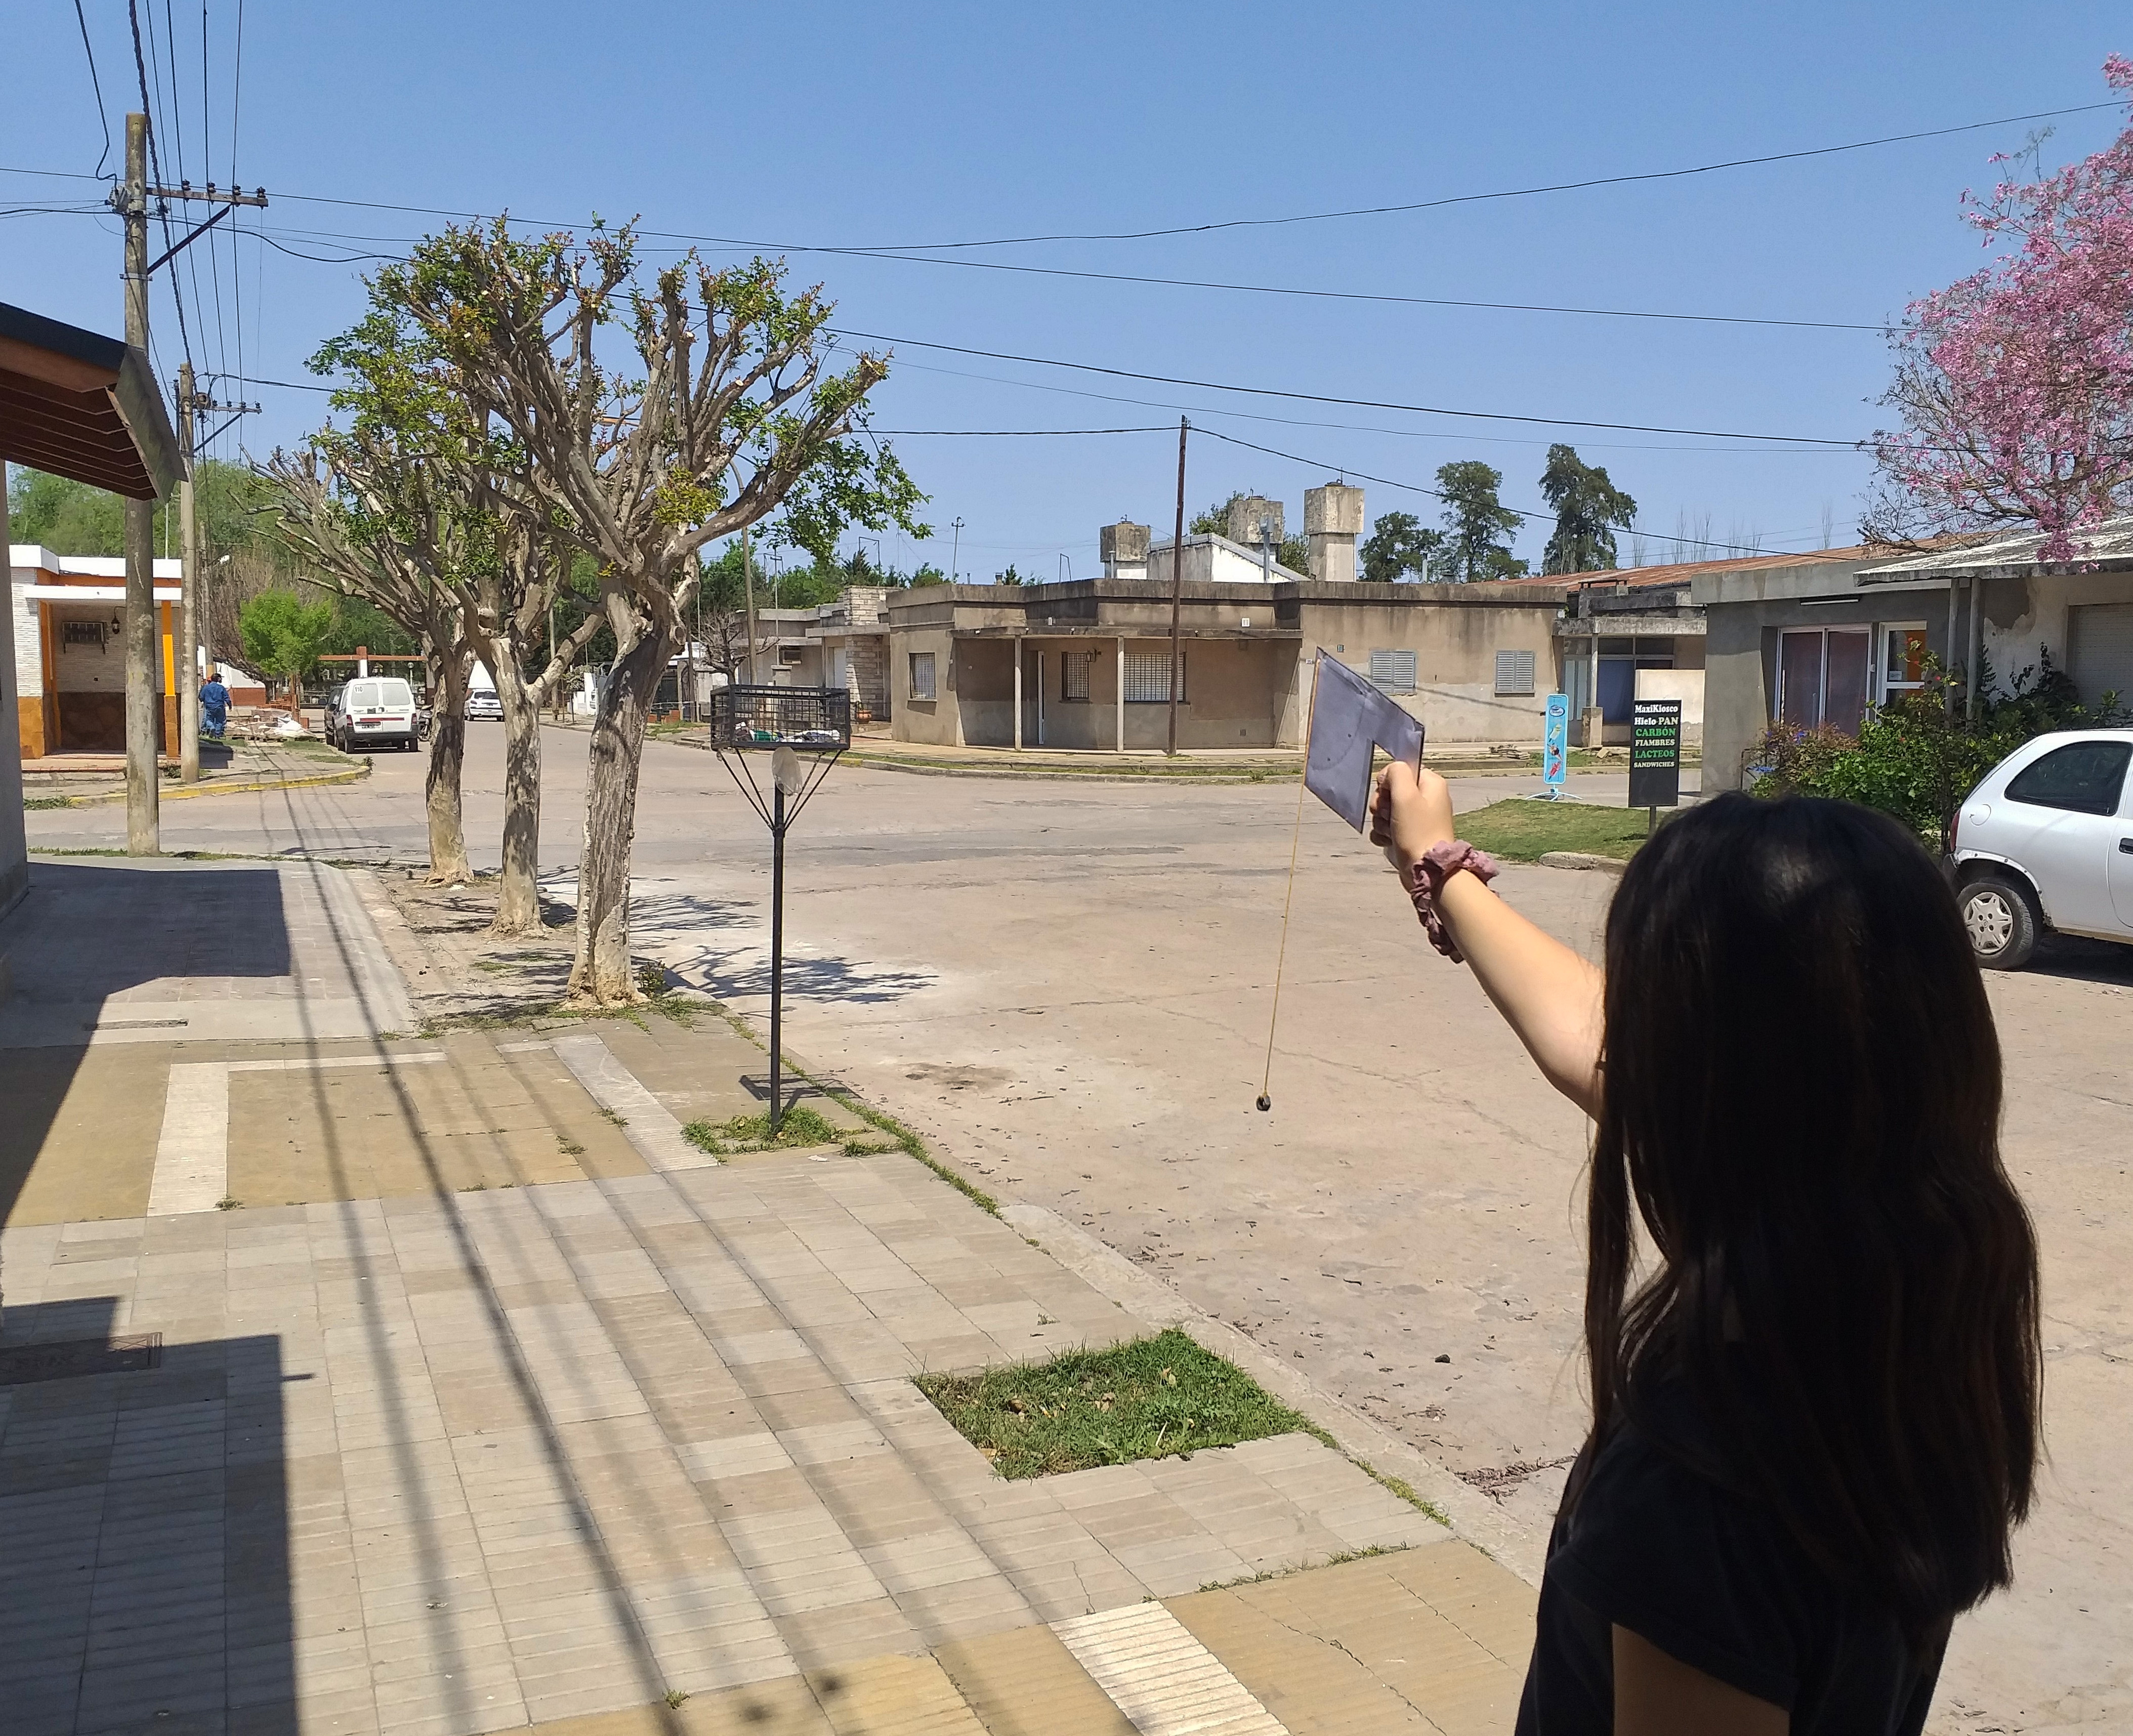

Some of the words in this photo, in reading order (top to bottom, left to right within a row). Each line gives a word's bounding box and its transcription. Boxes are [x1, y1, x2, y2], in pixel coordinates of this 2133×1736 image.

[1635, 704, 1678, 713] MaxiKiosco
[1636, 726, 1676, 736] CARBÓN
[1635, 750, 1675, 758] LACTEOS
